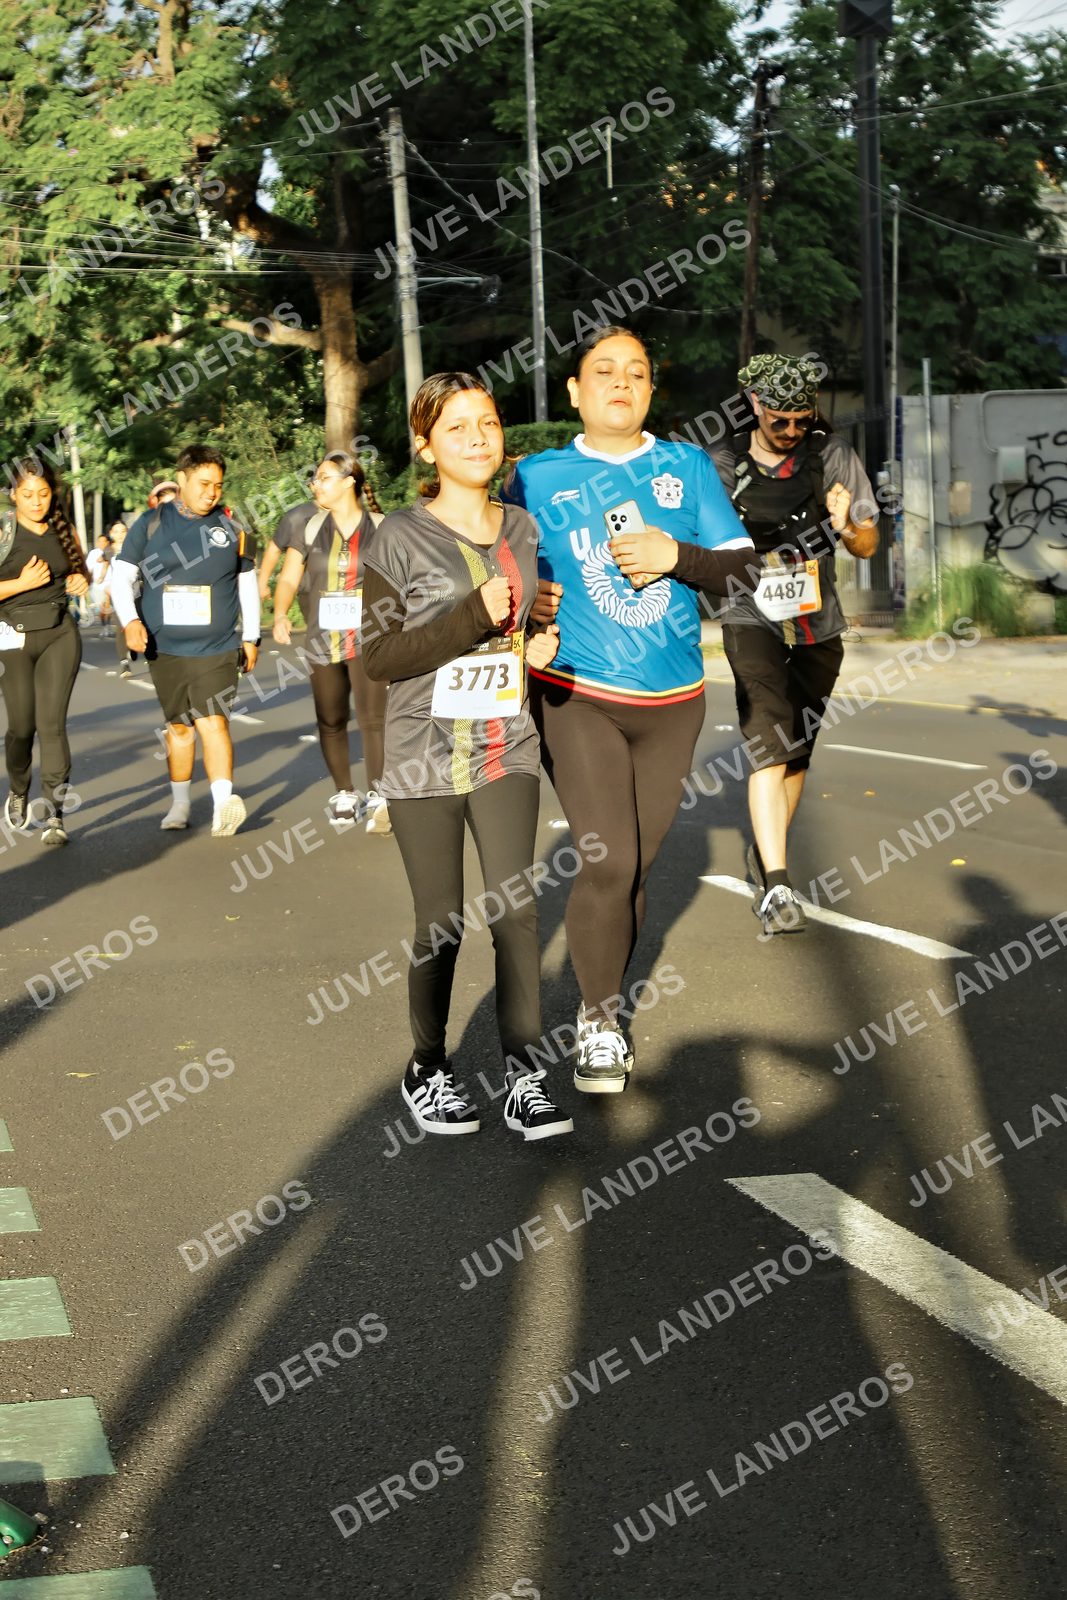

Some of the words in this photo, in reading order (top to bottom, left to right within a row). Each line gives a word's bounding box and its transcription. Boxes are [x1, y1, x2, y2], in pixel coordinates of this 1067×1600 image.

[763, 580, 806, 602] 4487
[327, 603, 357, 616] 1578
[448, 663, 510, 691] 3773
